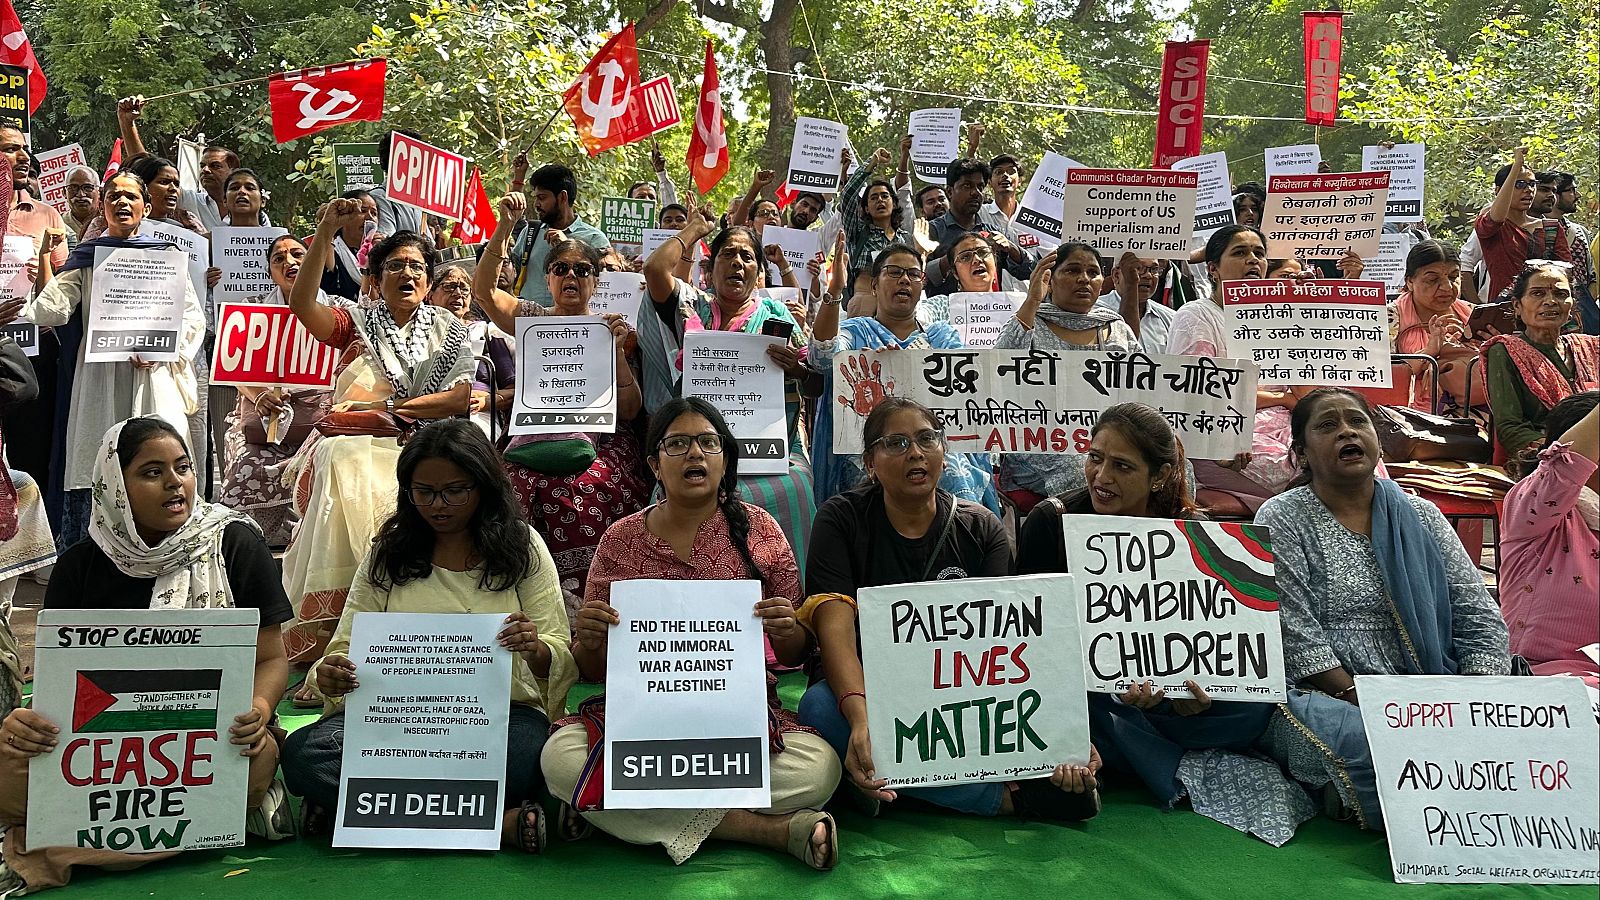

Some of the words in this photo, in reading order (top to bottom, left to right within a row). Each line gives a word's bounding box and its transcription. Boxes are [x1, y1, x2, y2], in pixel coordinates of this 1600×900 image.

[1311, 22, 1338, 113] AIDSO
[1169, 57, 1199, 147] SUCI
[392, 141, 461, 213] CPI(M)
[793, 174, 806, 182] SFI
[808, 175, 834, 185] DELHI
[1045, 176, 1062, 188] FREE
[1070, 172, 1113, 182] Communist
[1116, 173, 1144, 183] Ghadar
[1146, 175, 1165, 186] Party
[1168, 175, 1178, 184] of
[1178, 175, 1196, 185] India
[1312, 178, 1322, 188] की
[1087, 188, 1151, 201] Condemn
[1156, 190, 1176, 202] the
[1282, 195, 1339, 209] लेबनानी
[1343, 192, 1375, 207] लोगों
[605, 201, 653, 219] HALT
[1086, 207, 1136, 219] support
[1141, 206, 1154, 217] of
[1157, 207, 1176, 218] US
[1386, 205, 1416, 213] DELHI
[606, 218, 649, 227] US-ZIONIST
[1021, 213, 1036, 224] SFI
[1201, 214, 1230, 226] DELHI
[1275, 215, 1296, 225] पर
[1300, 213, 1357, 228] इज़रायल
[1360, 212, 1376, 222] का
[606, 226, 635, 234] CRIMES
[1077, 220, 1154, 235] imperialism
[1158, 223, 1180, 235] and
[1269, 228, 1340, 241] आतंकवादी
[1345, 229, 1376, 240] हमला
[153, 231, 178, 244] FROM
[179, 238, 194, 249] THE
[230, 236, 255, 245] FROM
[256, 237, 273, 245] THE
[1091, 237, 1124, 249] allies
[1127, 238, 1146, 250] for
[1149, 239, 1187, 251] Israel!
[224, 249, 249, 257] RIVER
[251, 249, 262, 257] TO
[789, 251, 804, 259] FREE
[243, 261, 263, 269] SEA,
[1227, 284, 1287, 301] पुरोगामी
[1292, 284, 1333, 297] महिला
[1337, 282, 1381, 297] संगठन
[970, 303, 991, 311] Modi
[992, 303, 1012, 311] Govt
[1236, 304, 1295, 320] अमरीकी
[1299, 308, 1379, 321] साम्राज्यवाद
[581, 327, 589, 338] में
[1233, 325, 1262, 340] और
[1267, 325, 1305, 339] उसके
[1310, 325, 1383, 342] सहयोगियों
[97, 336, 120, 348] SFI
[123, 336, 170, 348] DELHI
[220, 311, 332, 380] CPI(M)
[692, 346, 710, 357] मोदी
[712, 349, 739, 358] सरकार
[1252, 348, 1282, 361] द्वारा
[1287, 348, 1347, 363] इज़रायल
[1351, 346, 1369, 361] को
[542, 362, 584, 373] जनसंहार
[700, 362, 715, 372] कैसी
[717, 363, 729, 372] रीत
[731, 363, 737, 373] है
[738, 364, 766, 375] तुम्हारी?
[924, 352, 980, 397] युद्ध
[997, 349, 1064, 386] नहीं
[1163, 357, 1245, 399] चाहिए
[1297, 364, 1317, 380] की
[1321, 364, 1351, 380] निंदा
[1357, 366, 1384, 383] करें!
[539, 379, 549, 389] के
[540, 395, 573, 406] एकजुट
[575, 392, 586, 403] हों
[725, 394, 735, 402] पर
[1192, 410, 1215, 435] बंद
[1217, 405, 1247, 435] करो
[985, 427, 1091, 453] AIMSS
[1084, 529, 1176, 581] STOP
[1085, 579, 1236, 623] BOMBING
[630, 620, 658, 633] END
[660, 620, 685, 633] THE
[689, 620, 742, 633] ILLEGAL
[891, 595, 1043, 644] PALESTIAN
[58, 627, 119, 647] STOP
[123, 628, 202, 645] GENOCIDE
[389, 634, 407, 642] CALL
[409, 634, 429, 643] UPON
[431, 635, 445, 643] THE
[447, 635, 473, 643] INDIAN
[369, 645, 421, 654] GOVERNMENT
[423, 646, 433, 654] TO
[434, 646, 452, 654] TAKE
[638, 640, 667, 653] AND
[670, 639, 735, 653] IMMORAL
[365, 656, 399, 664] AGAINST
[1088, 631, 1268, 681] CHILDREN
[639, 660, 671, 673] WAR
[674, 659, 734, 672] AGAINST
[933, 642, 1030, 689] LIVES
[647, 679, 726, 693] PALESTINE!
[1384, 702, 1460, 729] SUPPRT
[1469, 702, 1570, 729] FREEDOM
[894, 688, 1049, 764] MATTER
[61, 730, 218, 787] CEASE
[622, 755, 662, 778] SFI
[671, 752, 750, 777] DELHI
[1397, 759, 1443, 790] AND
[1447, 760, 1518, 791] JUSTICE
[1528, 760, 1572, 790] FOR
[88, 787, 188, 822] FIRE
[356, 792, 397, 815] SFI
[404, 793, 485, 817] DELHI
[77, 819, 191, 850] NOW
[1424, 806, 1577, 850] PALESTINIAN
[1396, 863, 1450, 877] JIMMDARI
[1489, 867, 1530, 878] WELFAIR
